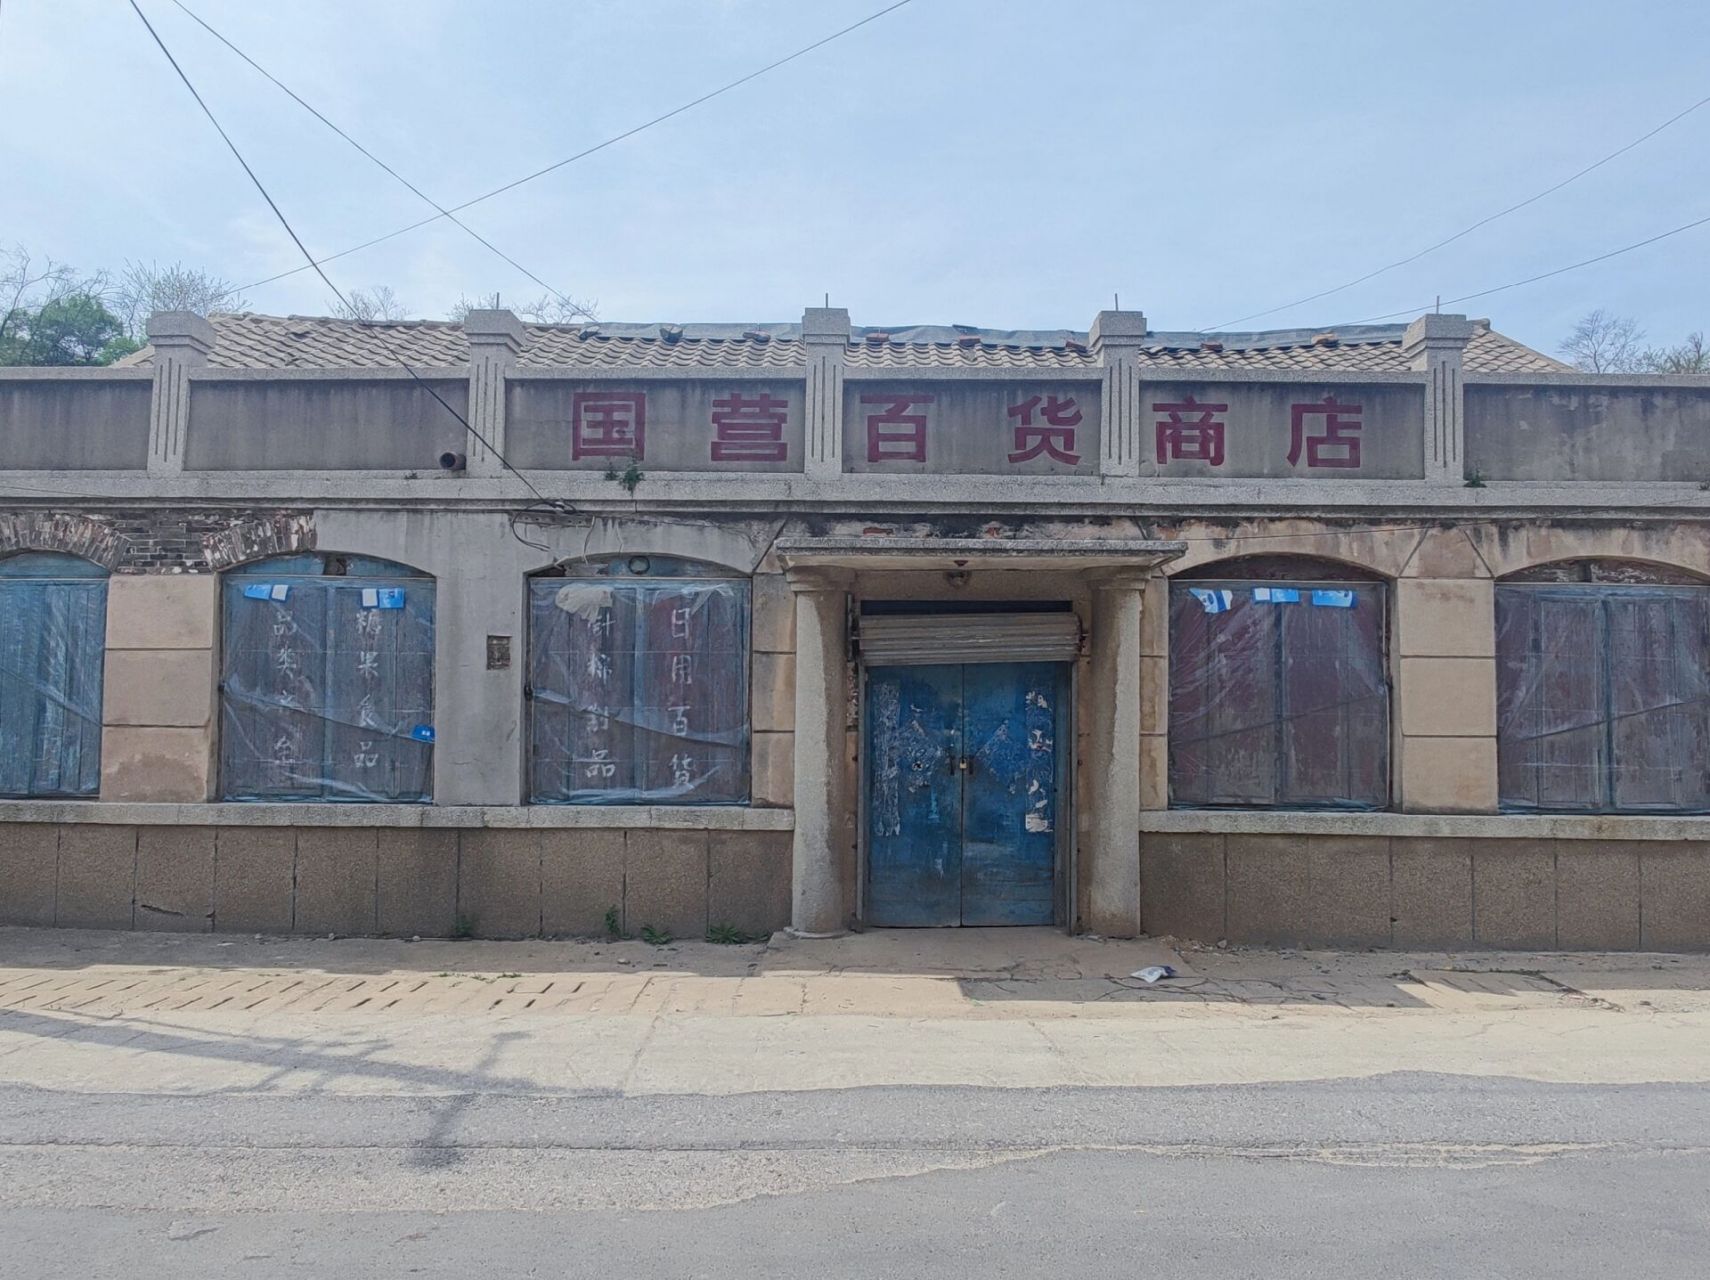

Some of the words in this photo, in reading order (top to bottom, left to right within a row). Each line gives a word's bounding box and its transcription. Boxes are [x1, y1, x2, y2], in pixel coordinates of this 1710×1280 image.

[572, 393, 1362, 467] 国营百货商店
[668, 607, 698, 786] 日用百货
